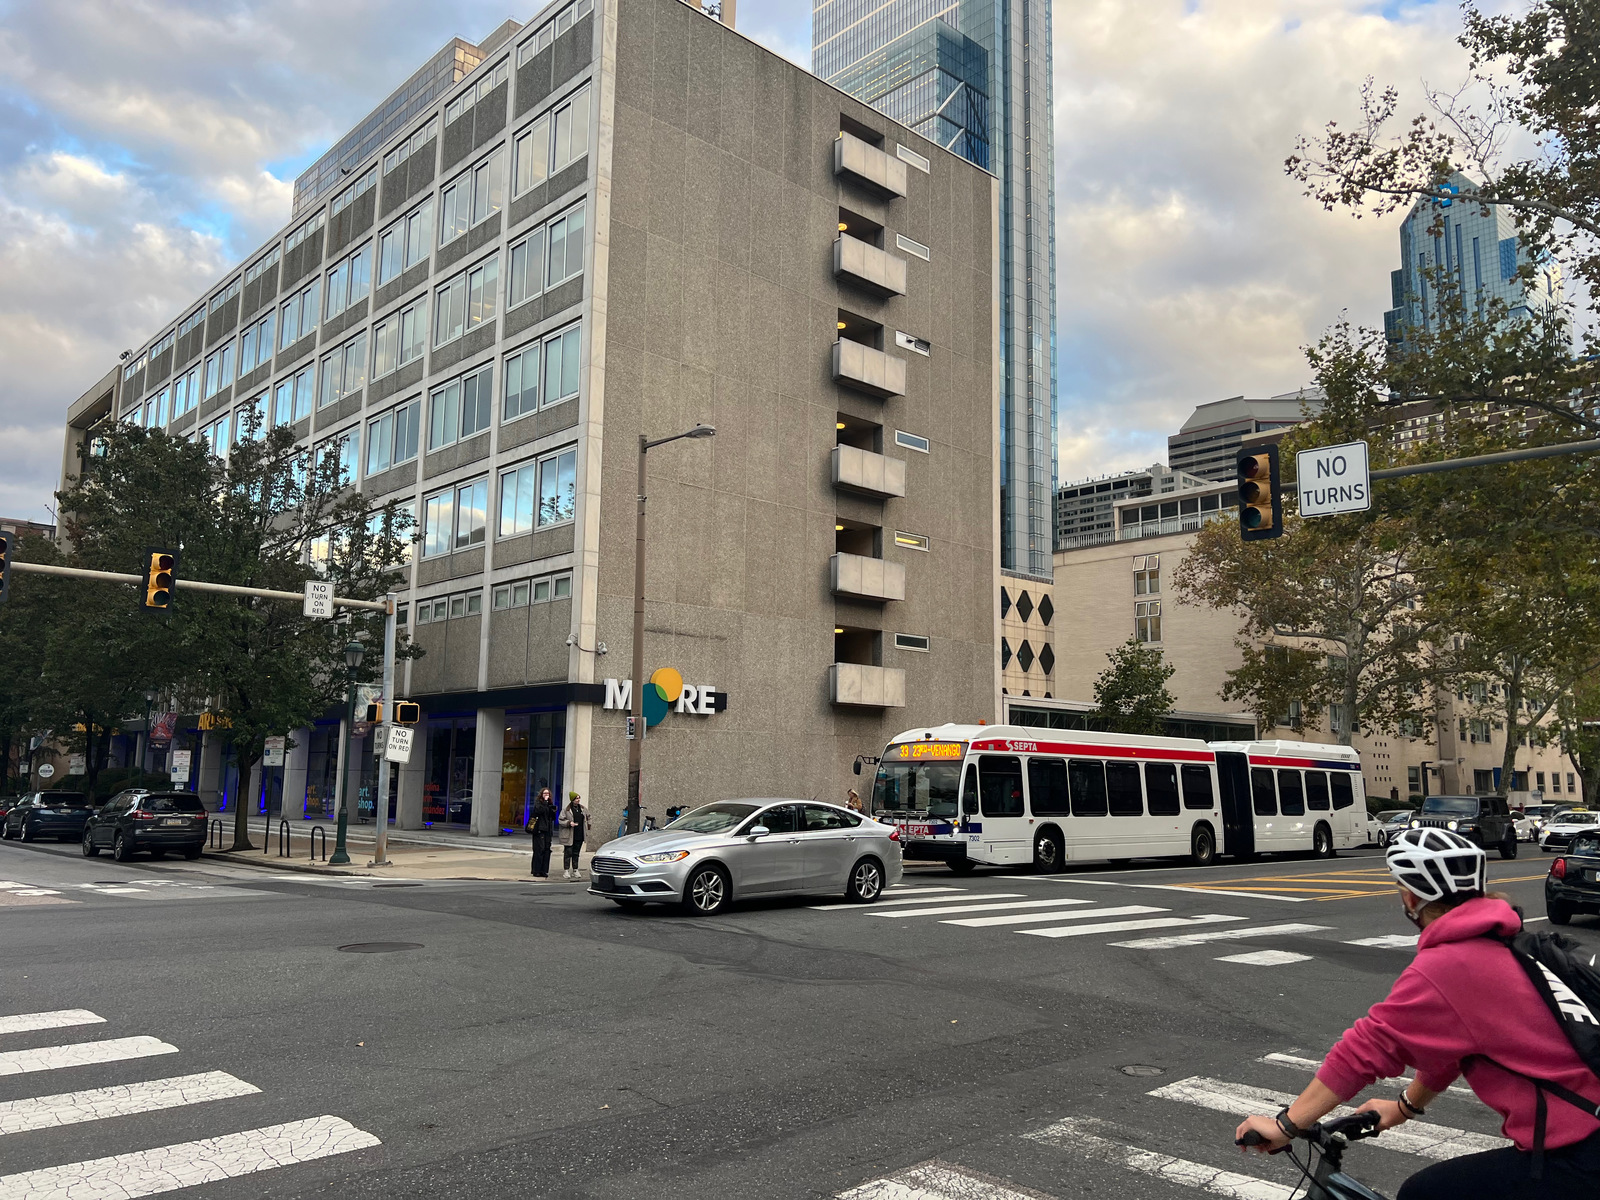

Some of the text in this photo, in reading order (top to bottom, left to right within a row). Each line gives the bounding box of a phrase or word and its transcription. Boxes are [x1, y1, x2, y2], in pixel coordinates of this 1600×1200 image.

[1317, 456, 1346, 478] NO
[1303, 484, 1365, 506] TURNS
[376, 730, 383, 740] NO
[395, 730, 407, 738] NO
[392, 737, 409, 745] TURN
[900, 744, 909, 757] 33
[1013, 742, 1038, 751] SEPTA
[357, 797, 375, 811] shop.
[903, 825, 929, 834] SEPTA
